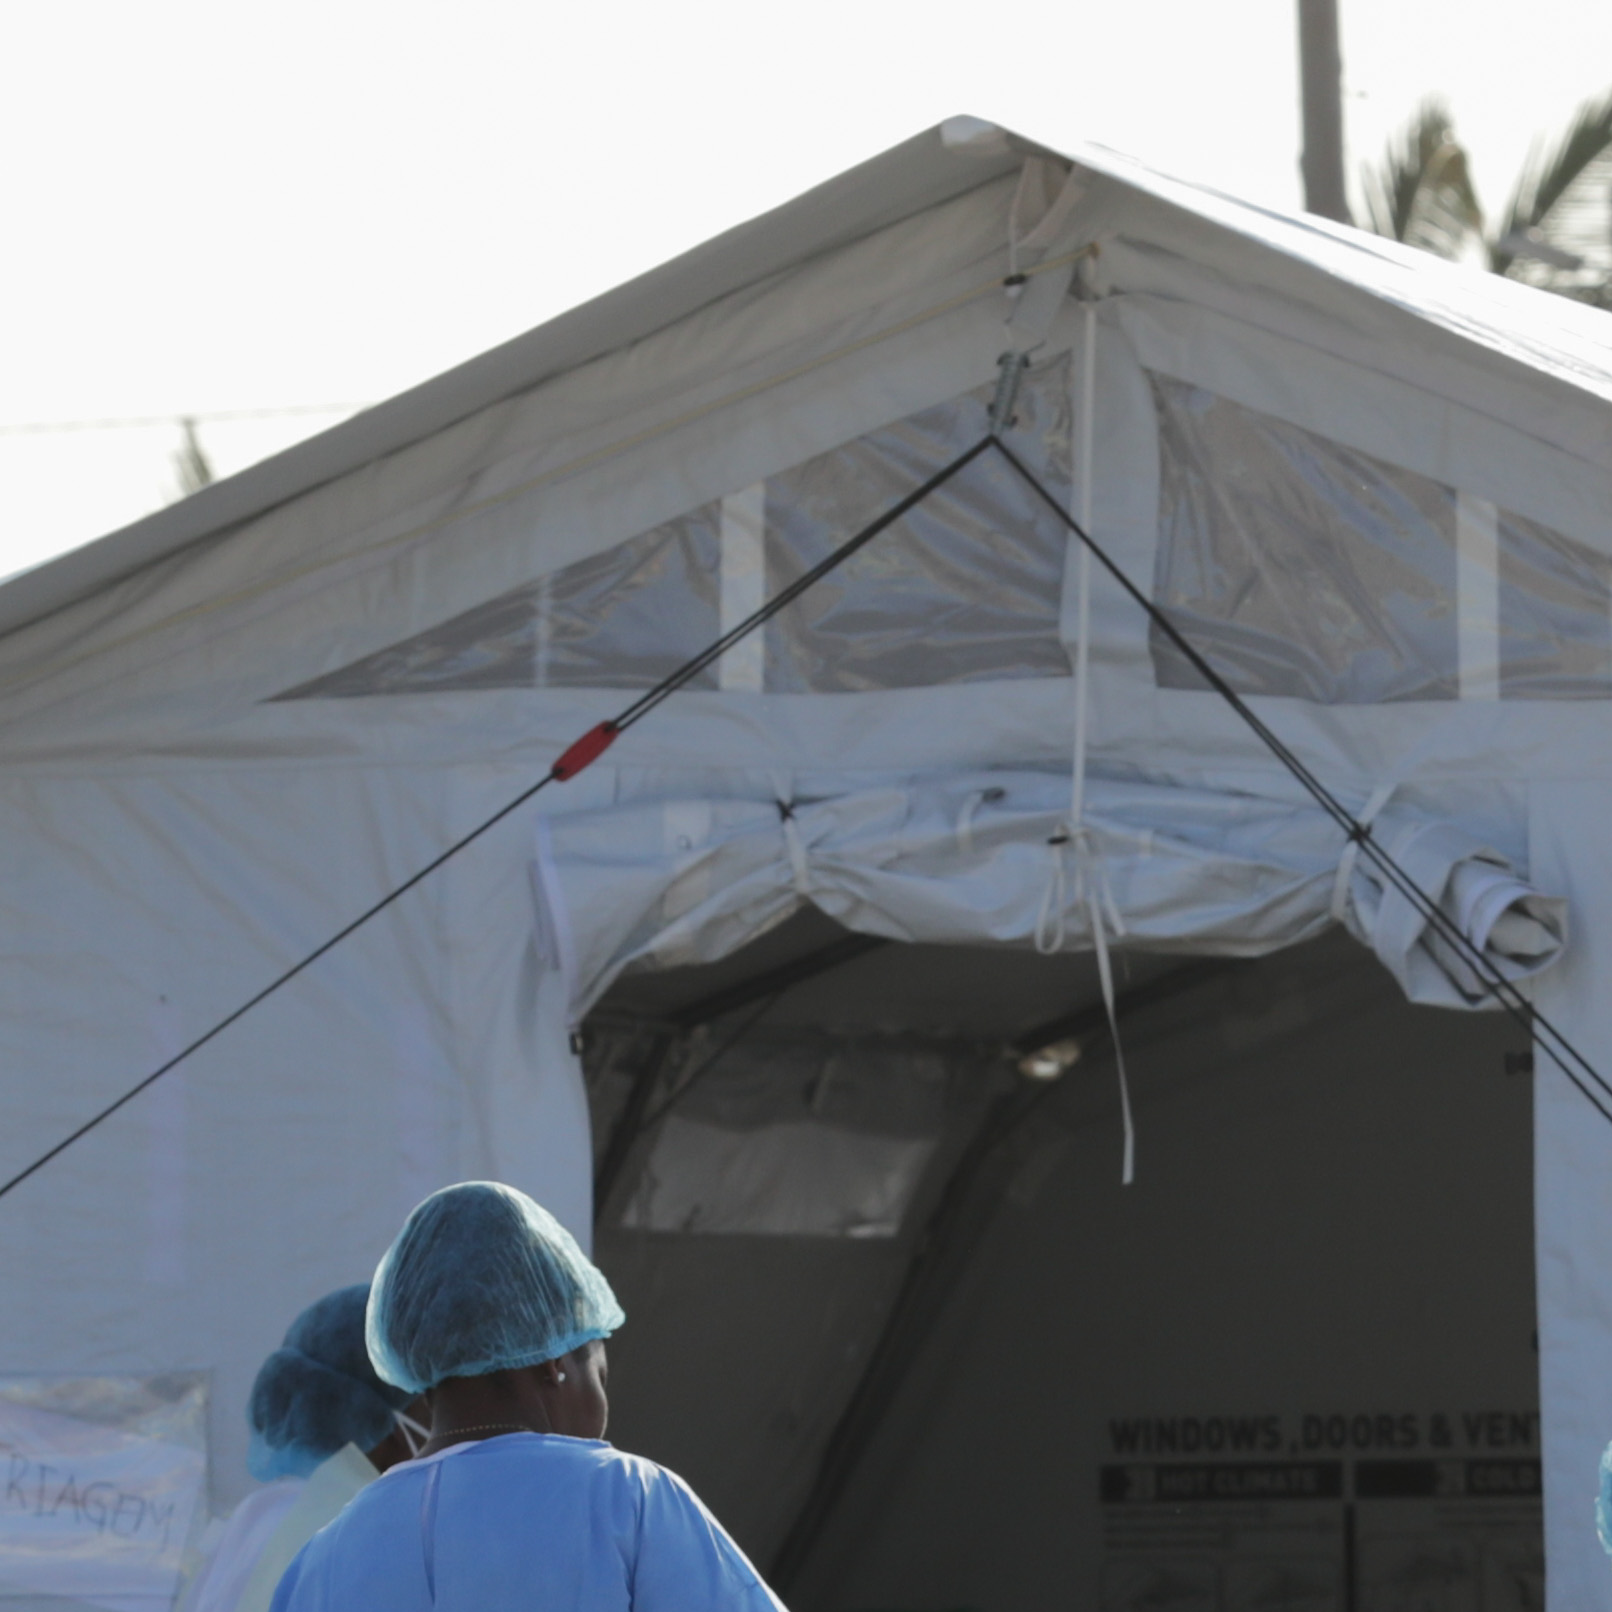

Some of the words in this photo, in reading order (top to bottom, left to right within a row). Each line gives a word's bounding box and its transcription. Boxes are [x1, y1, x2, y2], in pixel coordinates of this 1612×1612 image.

[1108, 1416, 1283, 1454] WINDOWS
[1429, 1412, 1454, 1449] &
[0, 1442, 175, 1556] RIAGEM
